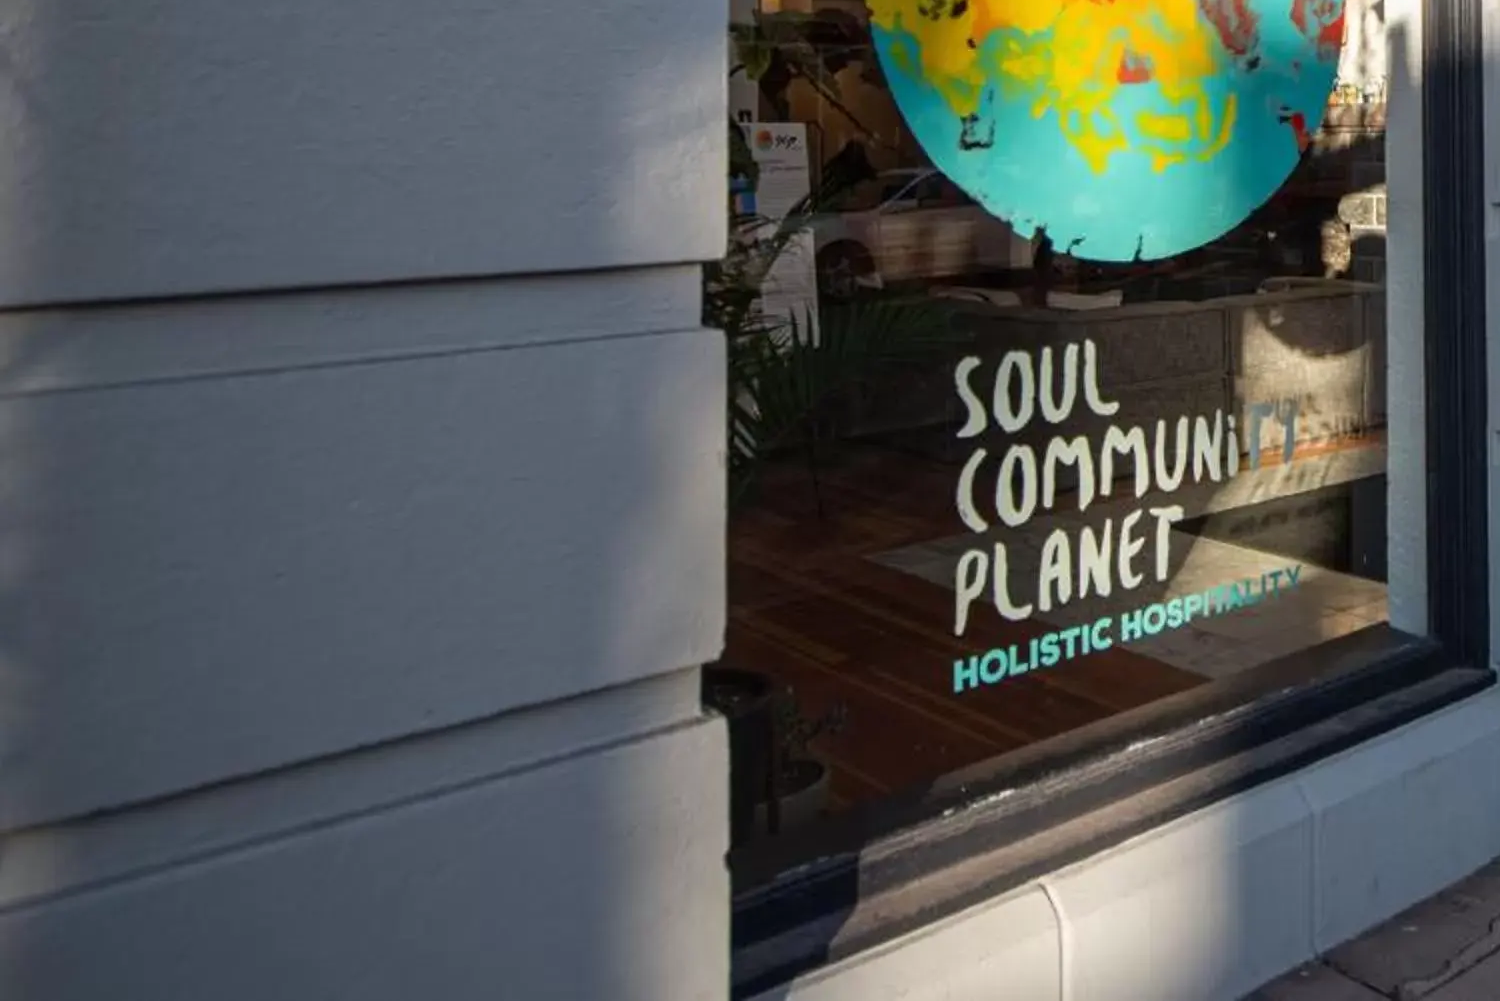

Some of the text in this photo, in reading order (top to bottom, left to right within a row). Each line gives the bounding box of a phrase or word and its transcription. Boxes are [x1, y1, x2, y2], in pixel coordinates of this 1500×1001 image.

[954, 339, 1119, 438] SOUL
[953, 565, 1302, 693] HOLISTIC HOSPITALITY
[954, 505, 1184, 636] PLANET
